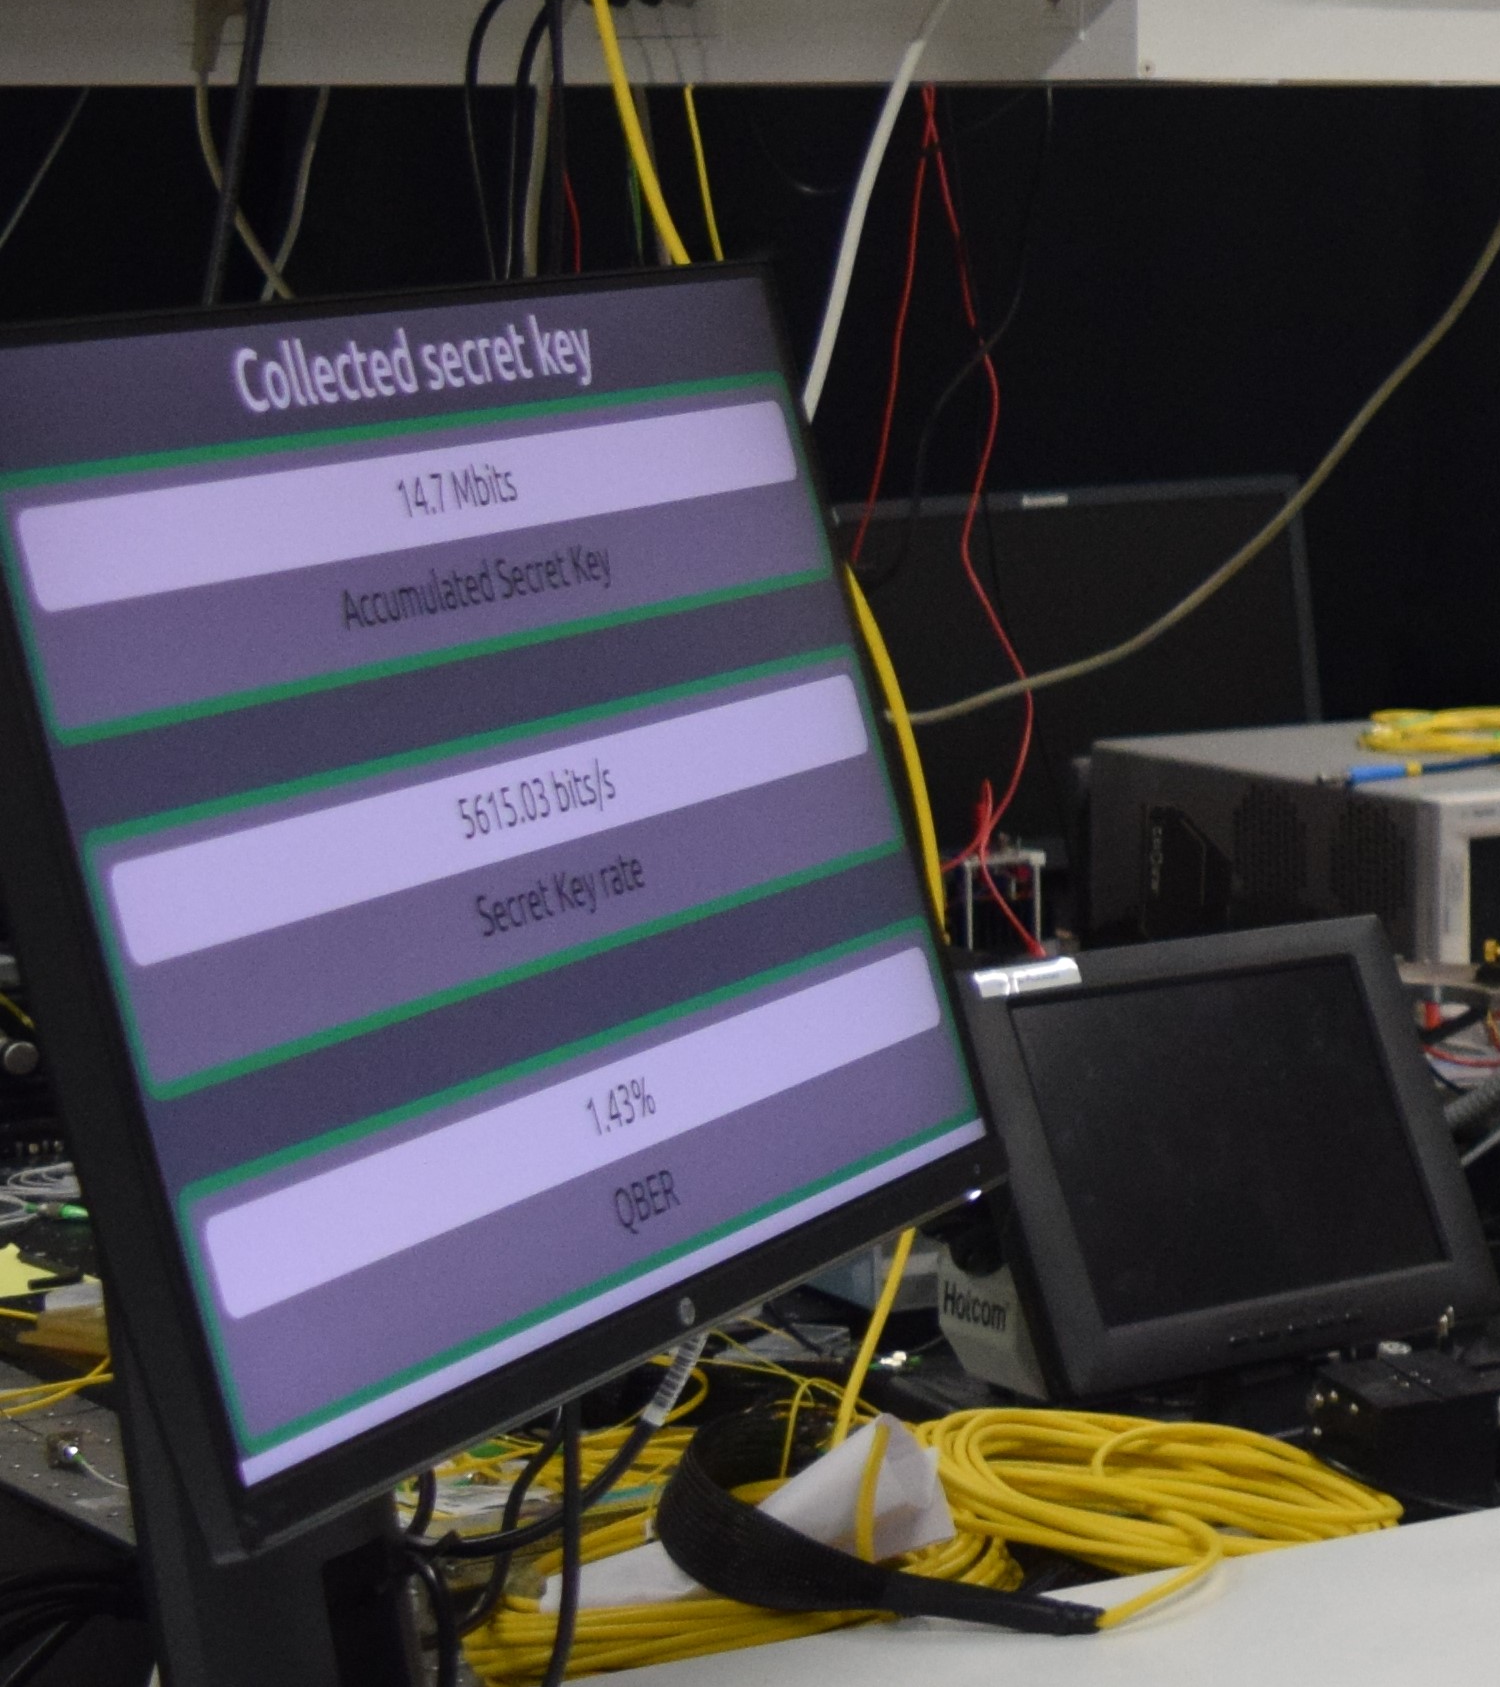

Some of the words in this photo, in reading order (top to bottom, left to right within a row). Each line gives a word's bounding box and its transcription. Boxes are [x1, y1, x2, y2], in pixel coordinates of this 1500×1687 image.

[234, 327, 419, 414] Collected
[420, 322, 535, 392] secret
[528, 314, 593, 387] key
[397, 472, 446, 518] 14.7
[450, 462, 519, 510] Mbits
[341, 559, 497, 631] Accumulated
[495, 546, 571, 600] Secret
[567, 544, 613, 590] Key
[457, 777, 551, 840] 5615.03
[549, 758, 617, 813] bits/s
[475, 879, 554, 938] Secret
[552, 870, 598, 915] Key
[599, 854, 646, 899] rate
[586, 1076, 657, 1136] 1.43%
[614, 1169, 681, 1235] QBER
